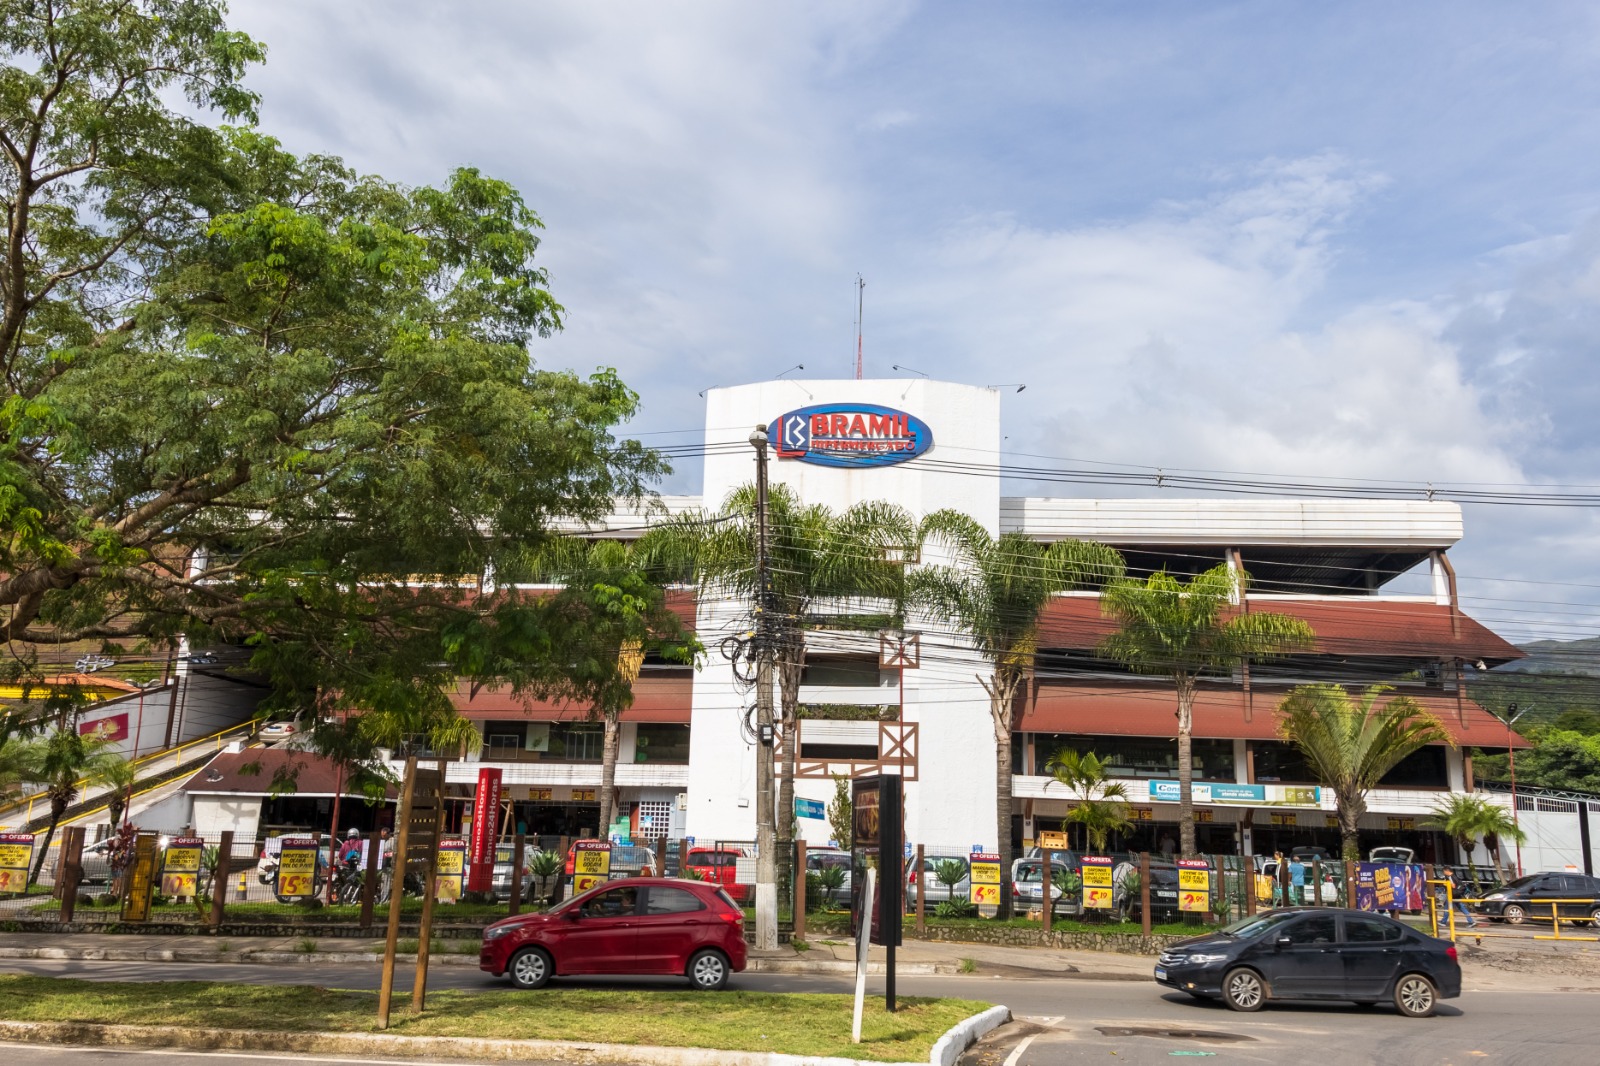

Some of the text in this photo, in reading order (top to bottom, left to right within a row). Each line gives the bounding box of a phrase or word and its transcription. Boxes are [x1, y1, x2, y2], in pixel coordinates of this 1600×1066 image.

[811, 414, 916, 436] BRAMIL
[473, 778, 486, 864] Banco24Horas
[484, 778, 499, 864] Banco24Horas
[279, 875, 313, 894] 15.90
[974, 886, 996, 903] 6.99
[1087, 890, 1108, 907] 5.19
[1183, 894, 1205, 910] 2.99
